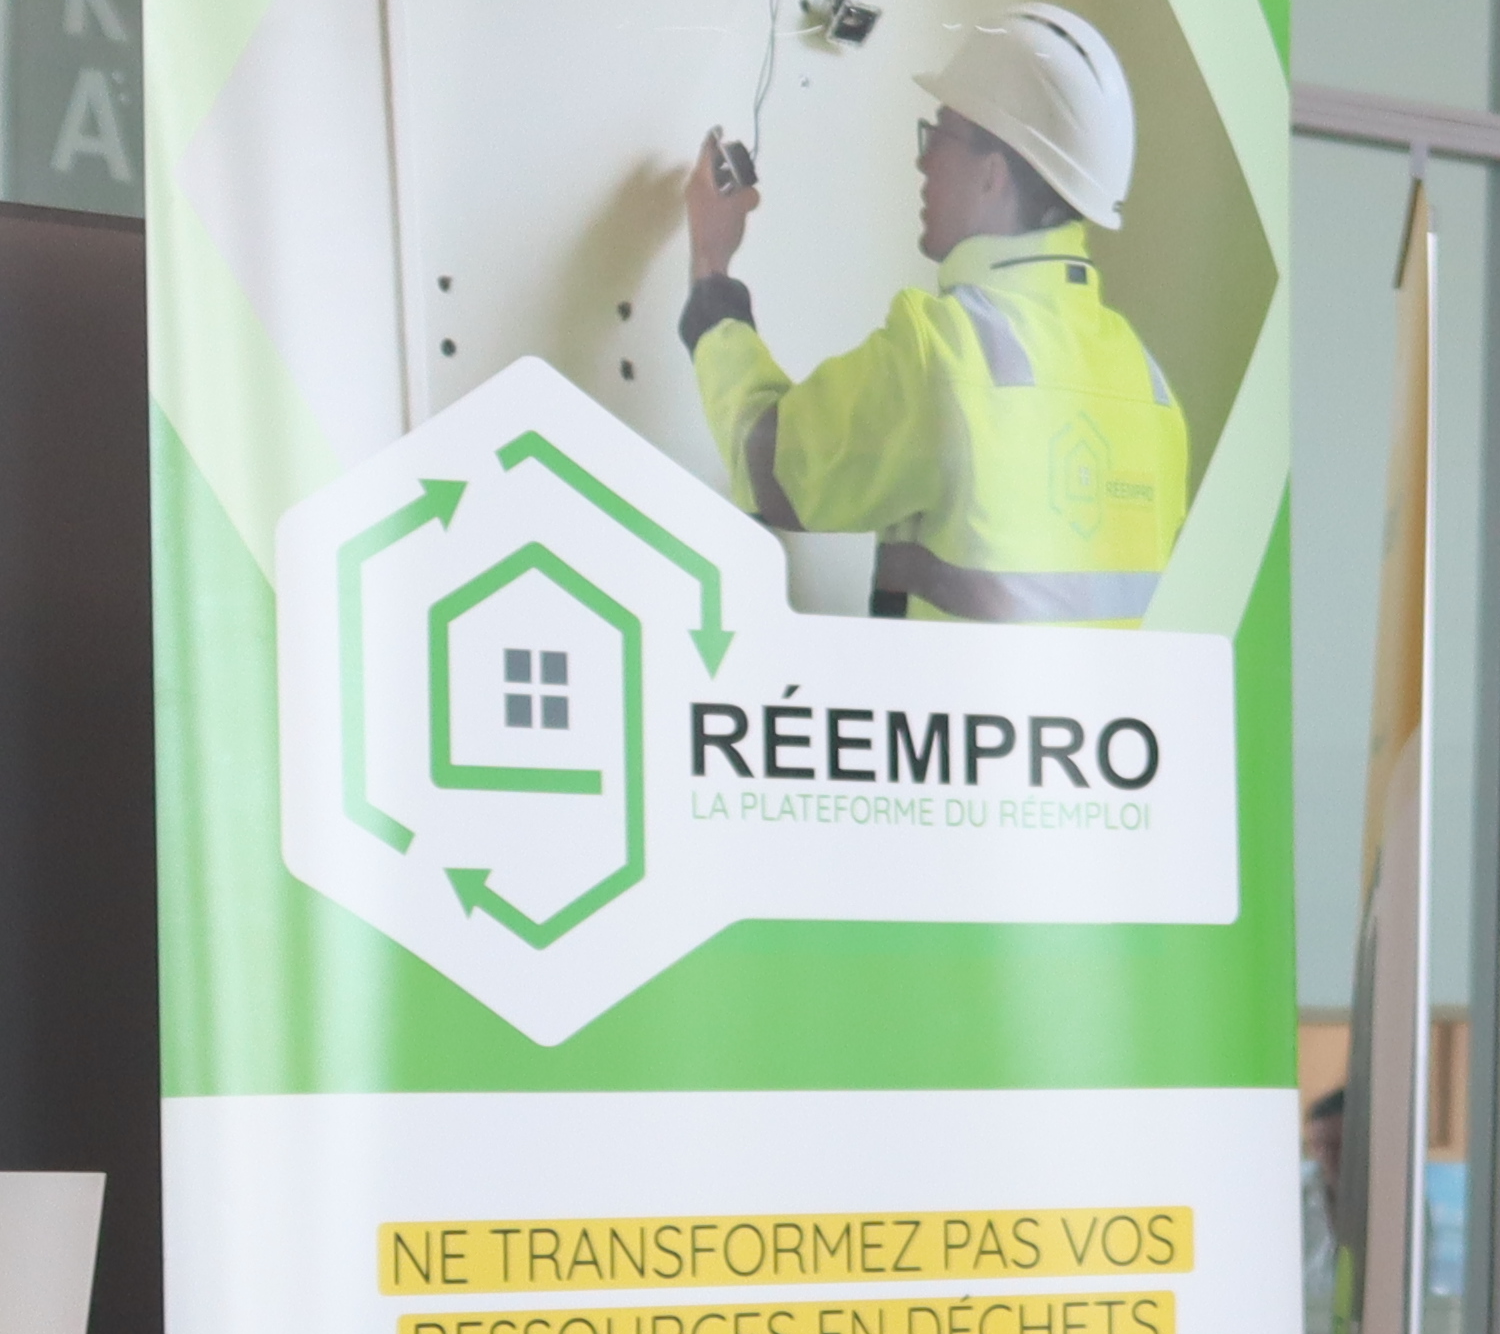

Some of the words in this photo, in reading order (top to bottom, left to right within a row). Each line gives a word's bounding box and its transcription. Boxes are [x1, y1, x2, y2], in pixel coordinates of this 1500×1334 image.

[689, 684, 1161, 791] RÉEMPRO
[691, 791, 729, 821] LA
[741, 792, 934, 828] PLATEFORME
[945, 798, 988, 828] DU
[999, 795, 1151, 832] RÉEMPLOI
[393, 1229, 469, 1286] NE
[490, 1219, 922, 1283] TRANSFORMEZ
[944, 1217, 1041, 1271] PAS
[1060, 1214, 1175, 1267] VOS
